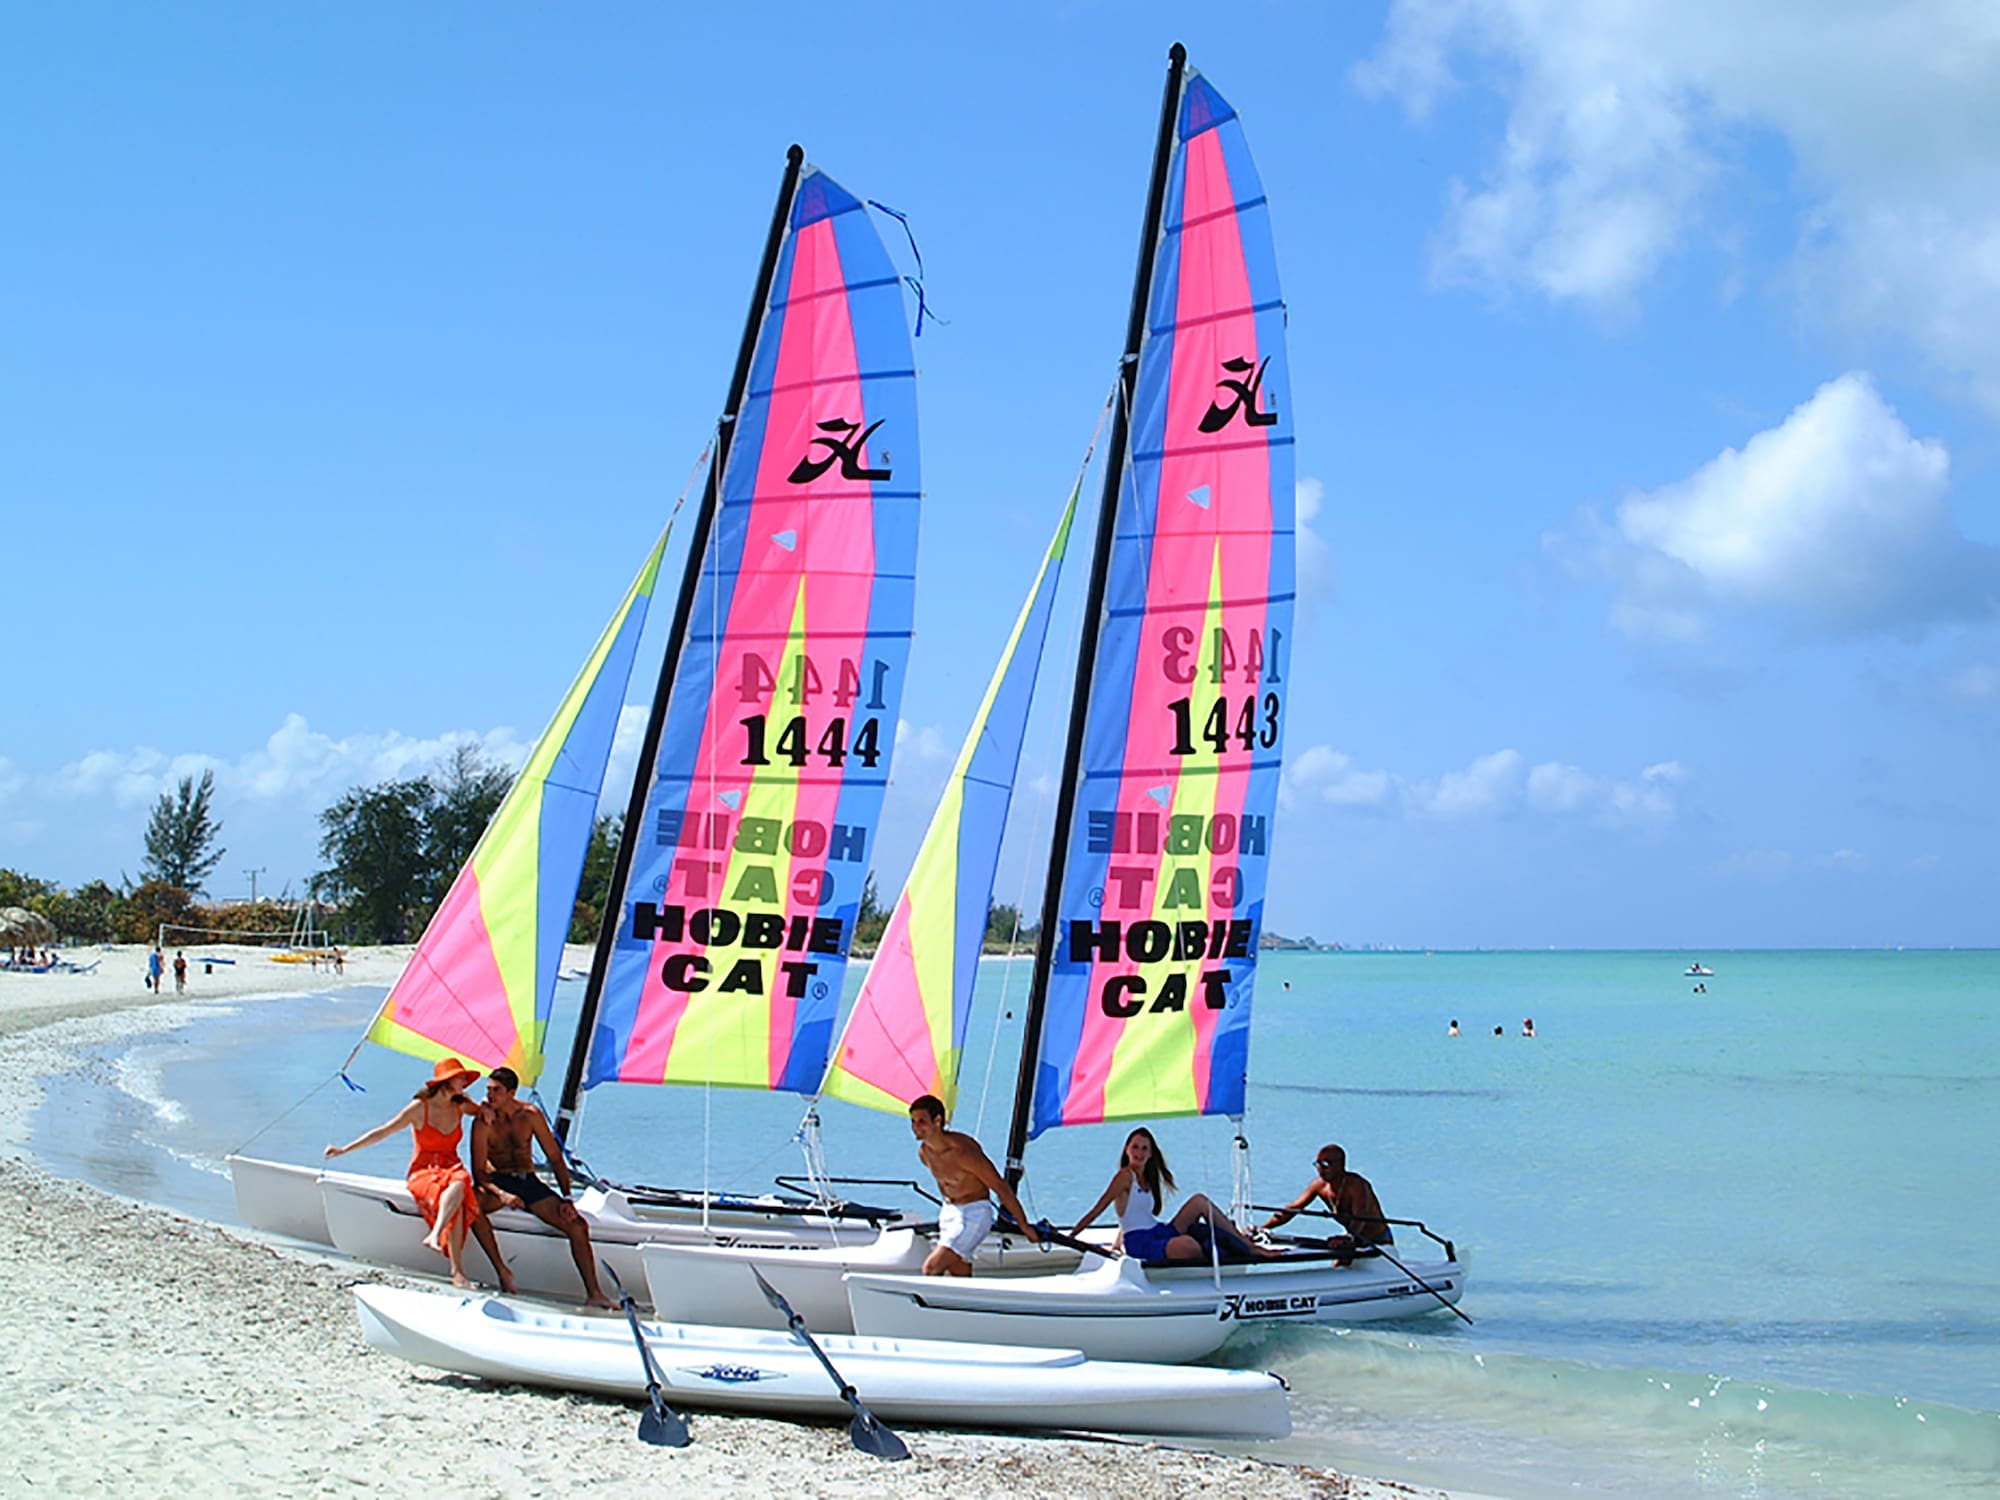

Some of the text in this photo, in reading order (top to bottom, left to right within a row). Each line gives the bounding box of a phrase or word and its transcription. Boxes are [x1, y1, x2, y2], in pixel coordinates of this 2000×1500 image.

[740, 715, 880, 767] 1444
[1167, 692, 1279, 755] 1443
[632, 902, 844, 954] HOBIE
[1070, 919, 1253, 963] HOBIE
[661, 954, 819, 999] CAT
[1101, 969, 1232, 1018] CAT
[1290, 1296, 1317, 1309] CAT
